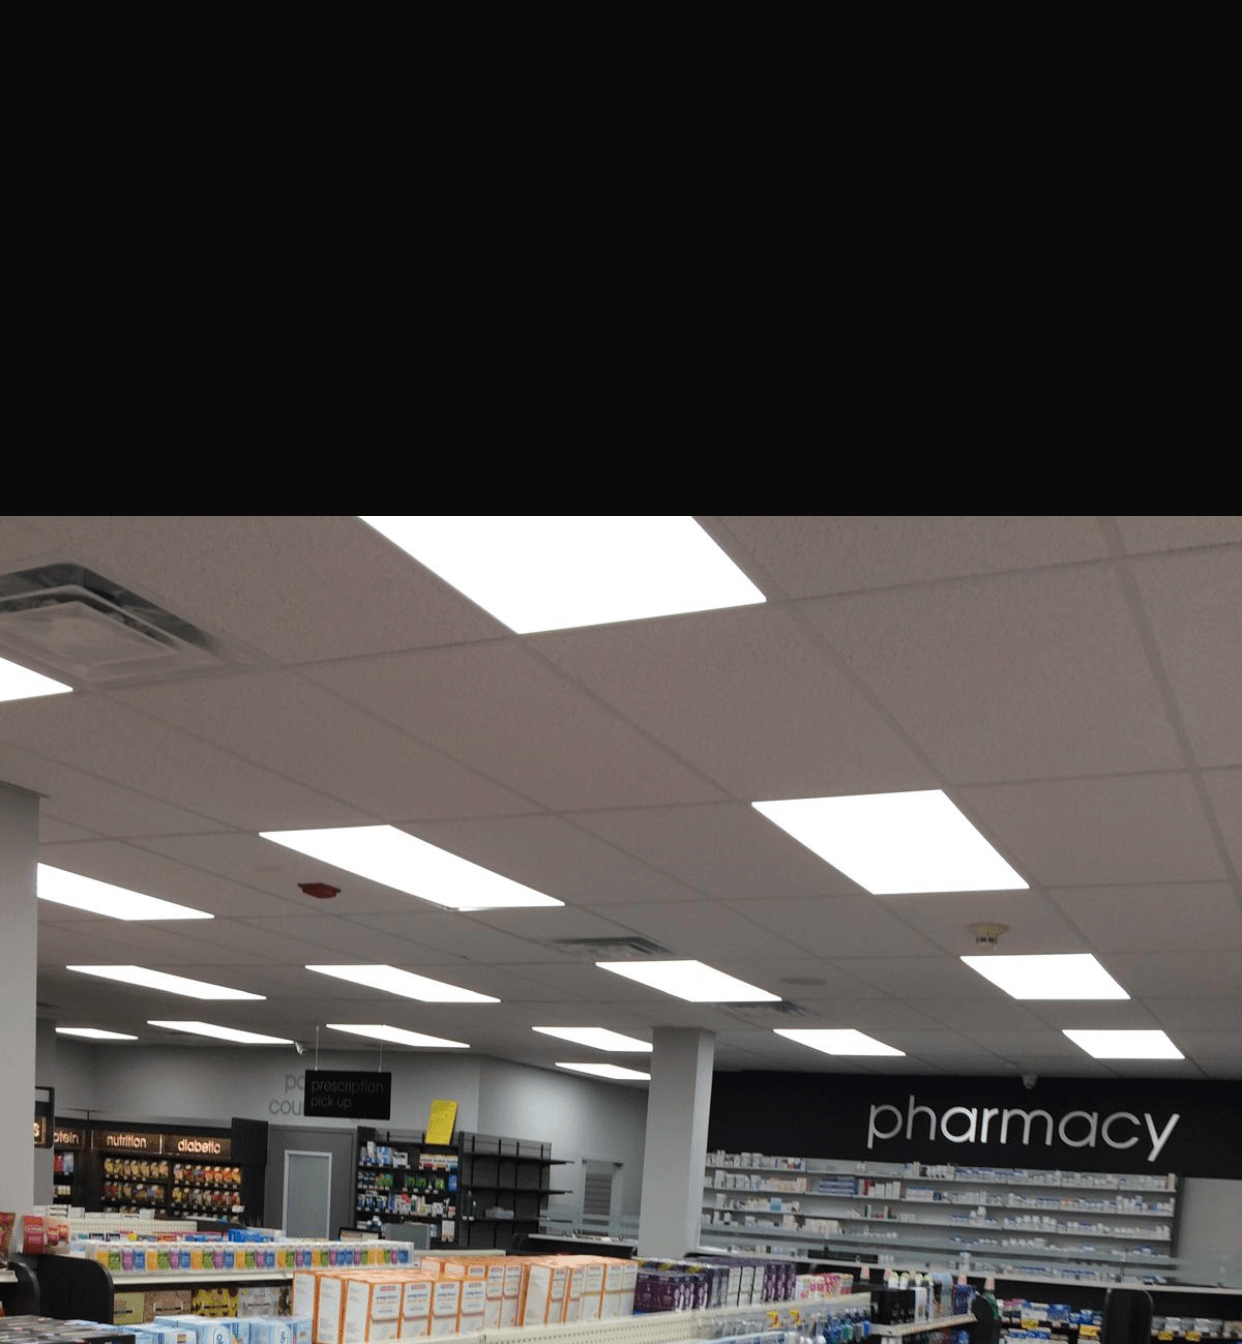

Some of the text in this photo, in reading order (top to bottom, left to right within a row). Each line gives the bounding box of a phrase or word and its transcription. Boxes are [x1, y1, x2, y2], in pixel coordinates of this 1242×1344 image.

[311, 1079, 384, 1094] prescription
[311, 1096, 333, 1108] pick
[337, 1099, 352, 1110] up
[867, 1095, 1180, 1162] pharmacy
[107, 1134, 147, 1149] nutrition
[178, 1138, 221, 1154] diabetic
